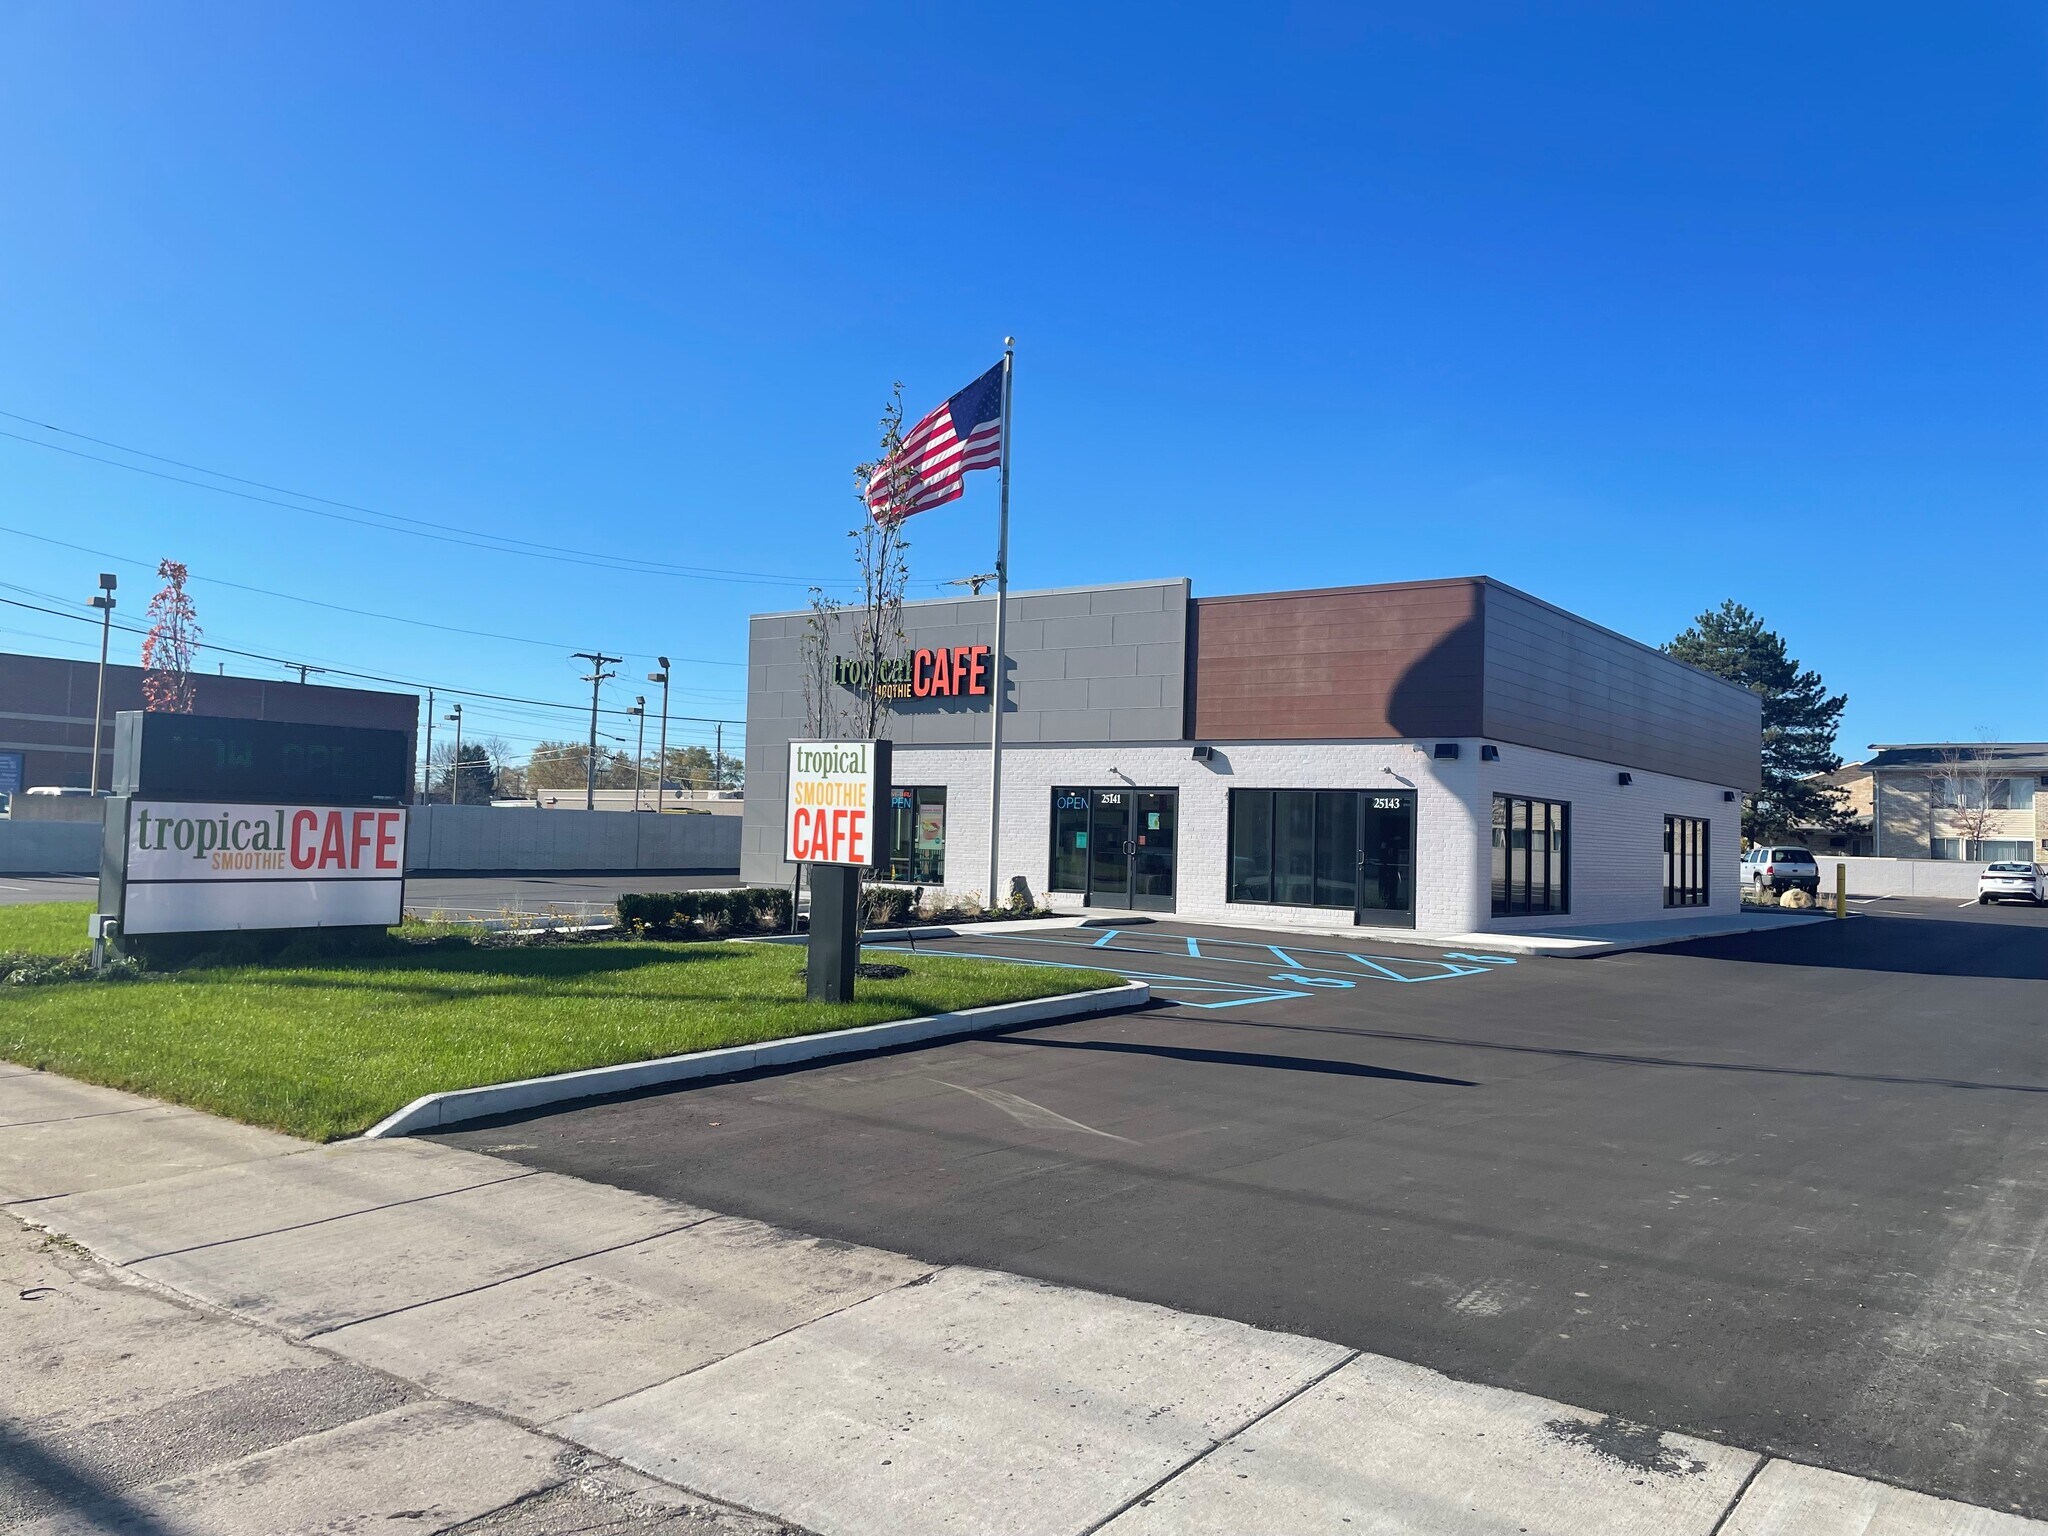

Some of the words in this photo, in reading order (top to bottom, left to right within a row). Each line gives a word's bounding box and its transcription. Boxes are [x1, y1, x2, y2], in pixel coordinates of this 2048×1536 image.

[913, 645, 988, 697] CAFE
[797, 744, 867, 779] tropical
[795, 781, 866, 807] SMOOTHIE
[891, 797, 911, 808] PEN
[1057, 796, 1089, 809] OPEN
[1101, 793, 1121, 804] 25141
[1373, 797, 1400, 809] 25143
[138, 808, 286, 860] tropical
[290, 809, 400, 870] CAFE
[793, 807, 866, 863] CAFE
[211, 852, 285, 871] SMOOTHIE
